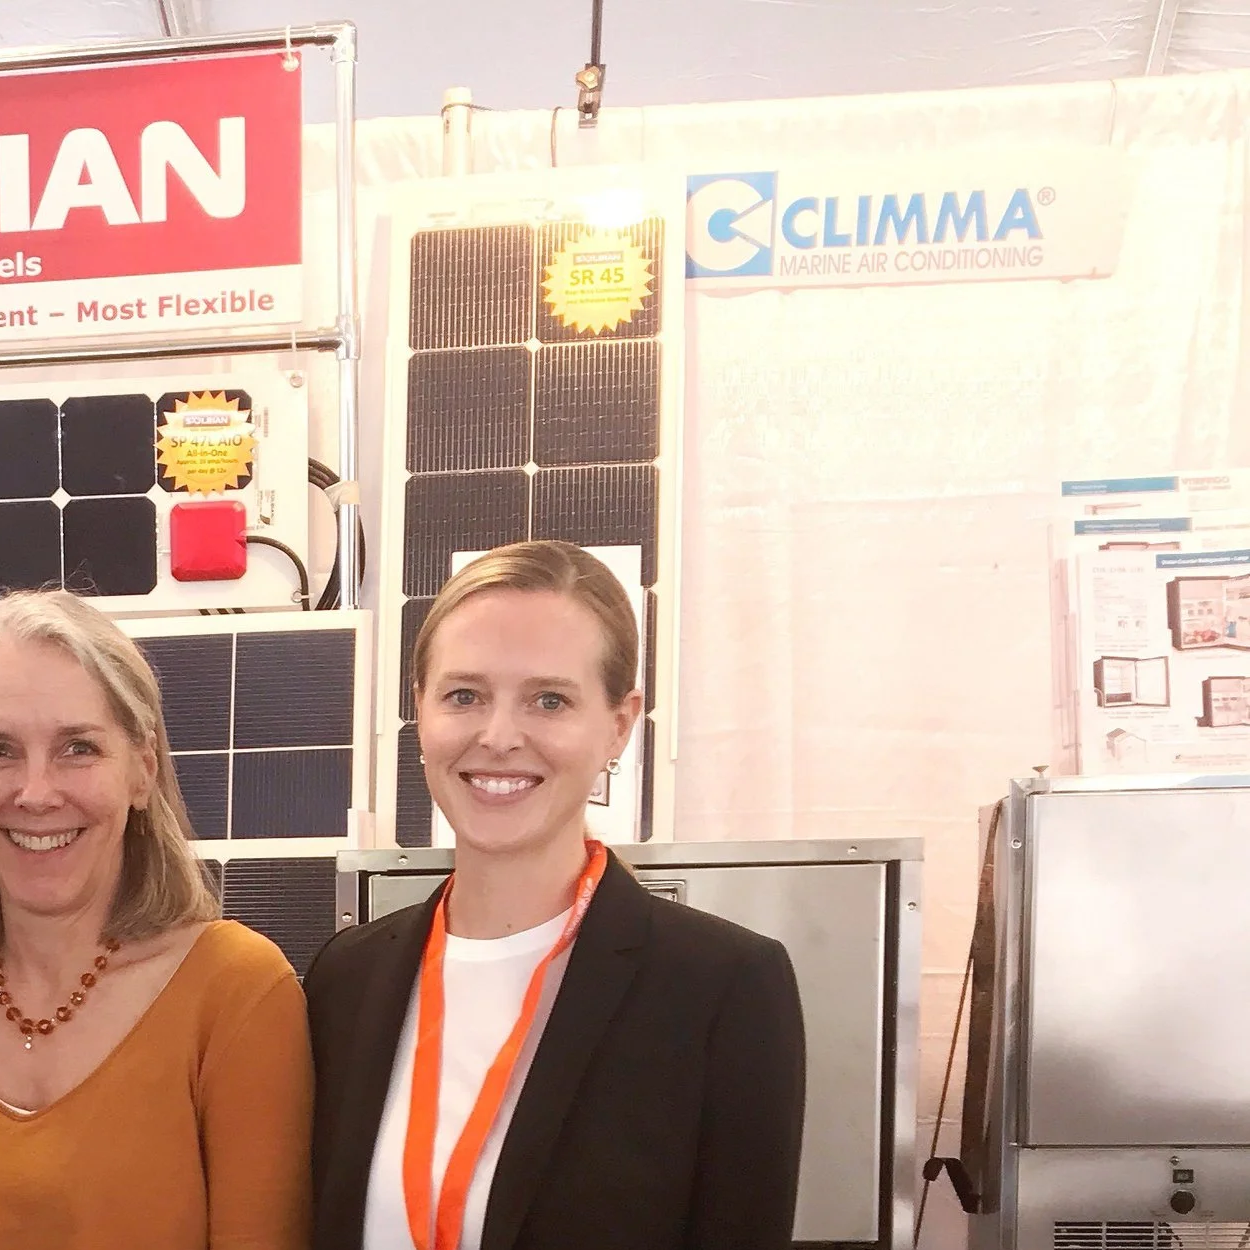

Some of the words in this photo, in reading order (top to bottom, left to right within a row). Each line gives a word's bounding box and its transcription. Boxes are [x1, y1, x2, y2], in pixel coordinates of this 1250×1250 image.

[570, 269, 594, 286] SR
[600, 267, 625, 284] 45
[780, 254, 852, 277] MARINE
[857, 252, 888, 273] AIR
[894, 244, 1045, 273] CONDITIONING
[77, 298, 148, 323] Most
[158, 289, 275, 318] Flexible
